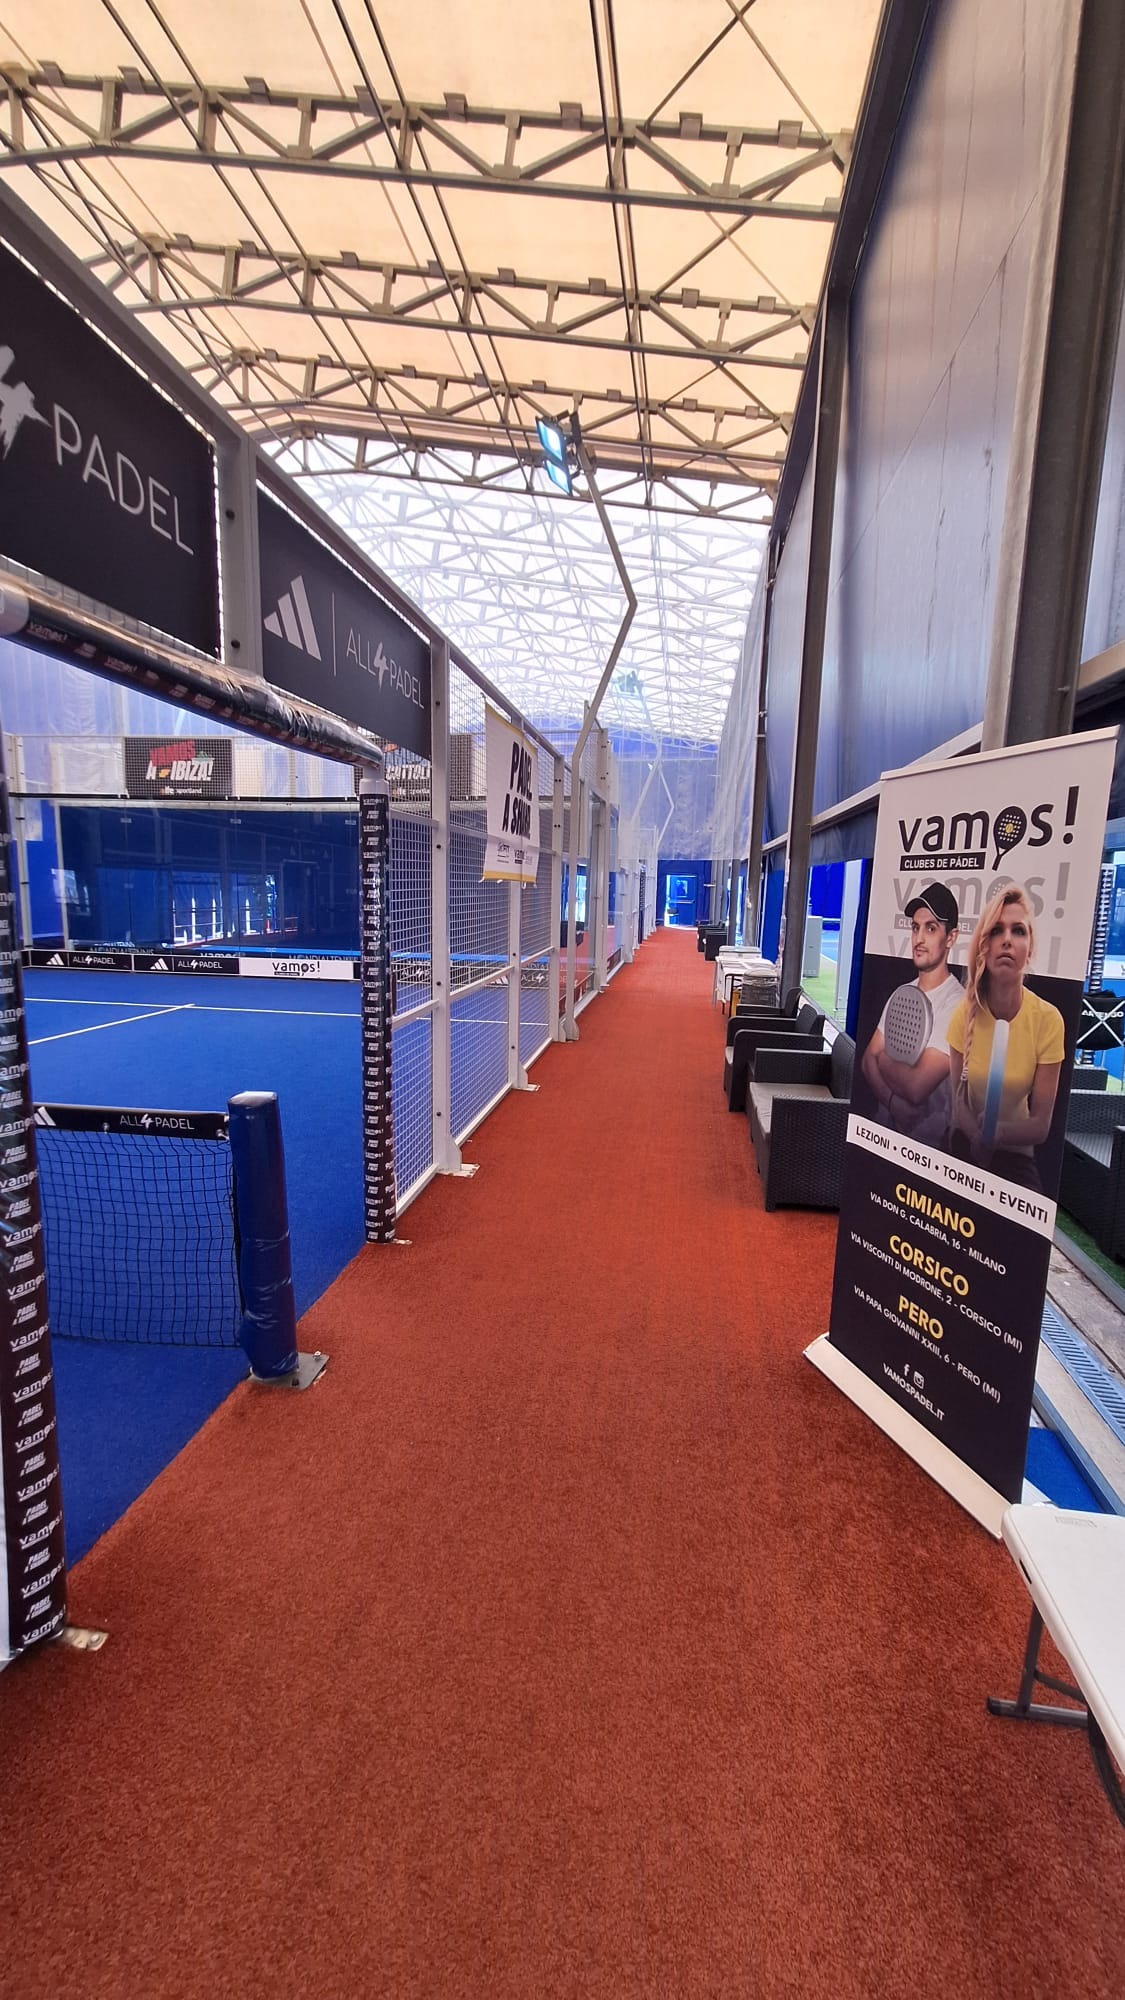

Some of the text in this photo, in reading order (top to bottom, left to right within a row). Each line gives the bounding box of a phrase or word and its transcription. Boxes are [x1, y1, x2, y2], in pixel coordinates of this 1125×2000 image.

[346, 627, 424, 709] ALL4PADEL
[170, 758, 214, 781] IBIZA!
[898, 785, 1080, 871] vamos!
[904, 856, 979, 869] CLUBES DE PÁDEL
[72, 955, 116, 965] ALL4PADEL
[178, 959, 223, 970] ALL4PADEL
[272, 961, 321, 976] vamos!
[119, 1113, 195, 1130] ALL4PADEL
[856, 1125, 1048, 1224] LEZIONI CORSI TORNEI EVENTI
[870, 1191, 882, 1205] VIA
[882, 1199, 899, 1215] DON
[900, 1209, 908, 1220] G.
[909, 1215, 949, 1245] CALABRIA,
[952, 1238, 961, 1250] 16
[968, 1247, 1007, 1275] MILANO
[895, 1183, 976, 1238] CIMIANO
[850, 1231, 861, 1245] VIA
[862, 1239, 894, 1266] VISCONTI
[894, 1261, 902, 1272] DI
[902, 1266, 944, 1301] MODRONE,
[946, 1295, 952, 1306] 2
[959, 1304, 1002, 1337] CORSICO
[1003, 1331, 1023, 1353] (MI)
[889, 1235, 969, 1296] CORSICO
[854, 1285, 865, 1300] VIA
[866, 1294, 883, 1314] PAPA
[883, 1308, 920, 1341] GIOVANNI
[944, 1354, 950, 1363] 6
[957, 1362, 981, 1386] PERO
[982, 1381, 1001, 1404] (MI)
[898, 1295, 944, 1339] PERO
[883, 1362, 945, 1421] VAMOSPADEL.IT
